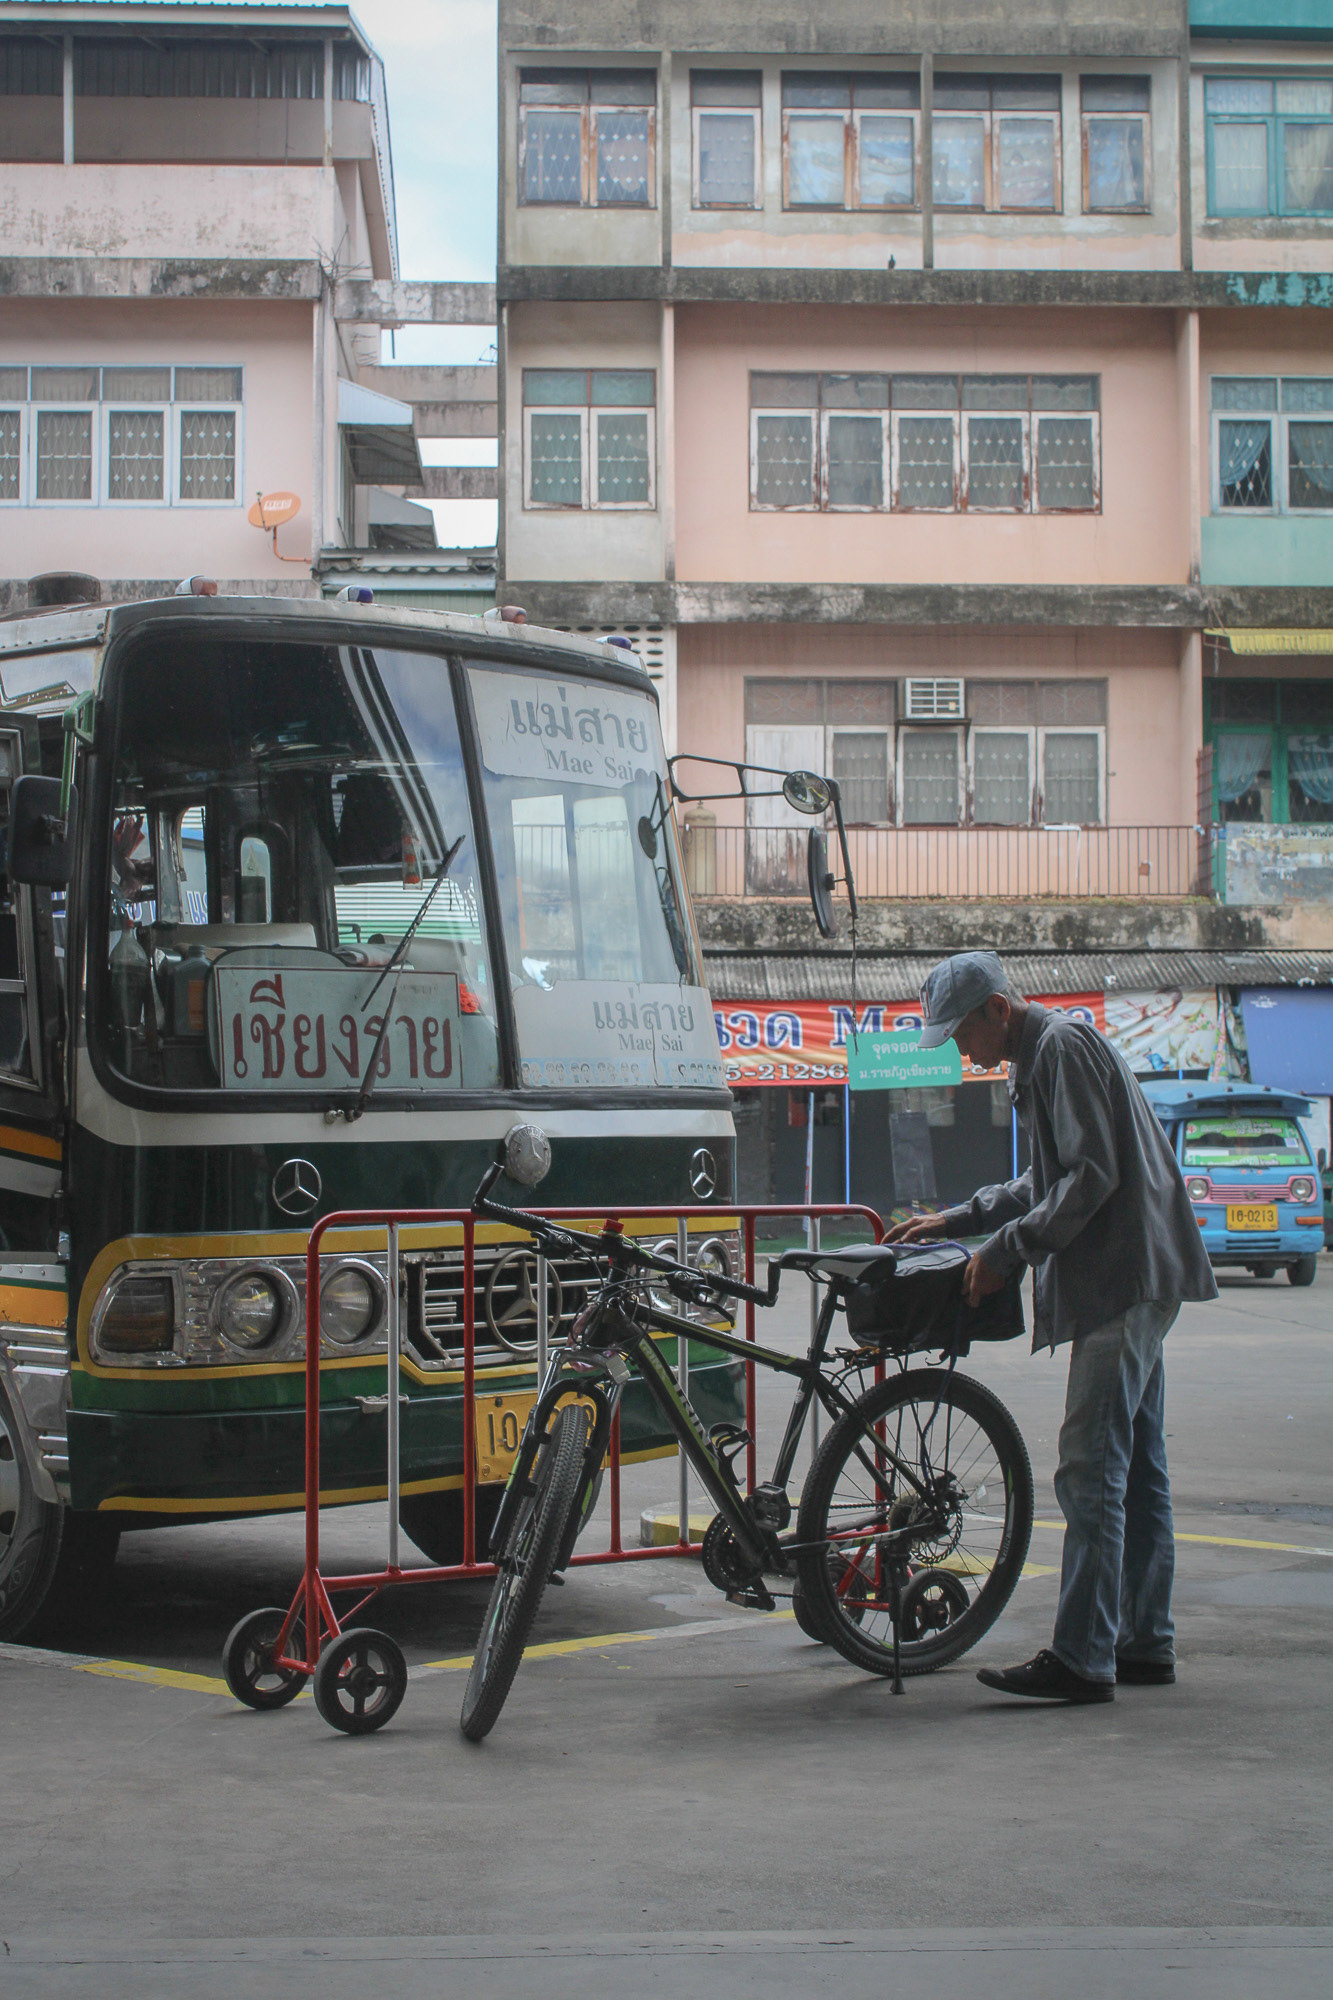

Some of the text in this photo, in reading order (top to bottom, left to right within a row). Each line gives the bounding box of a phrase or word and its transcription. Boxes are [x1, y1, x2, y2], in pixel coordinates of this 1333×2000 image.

[510, 686, 648, 753] แม่สาย
[546, 749, 633, 781] Mae Sai
[232, 973, 453, 1079] เชียงราย
[592, 986, 695, 1042] แม่สาย
[618, 1033, 683, 1051] Mae Sai
